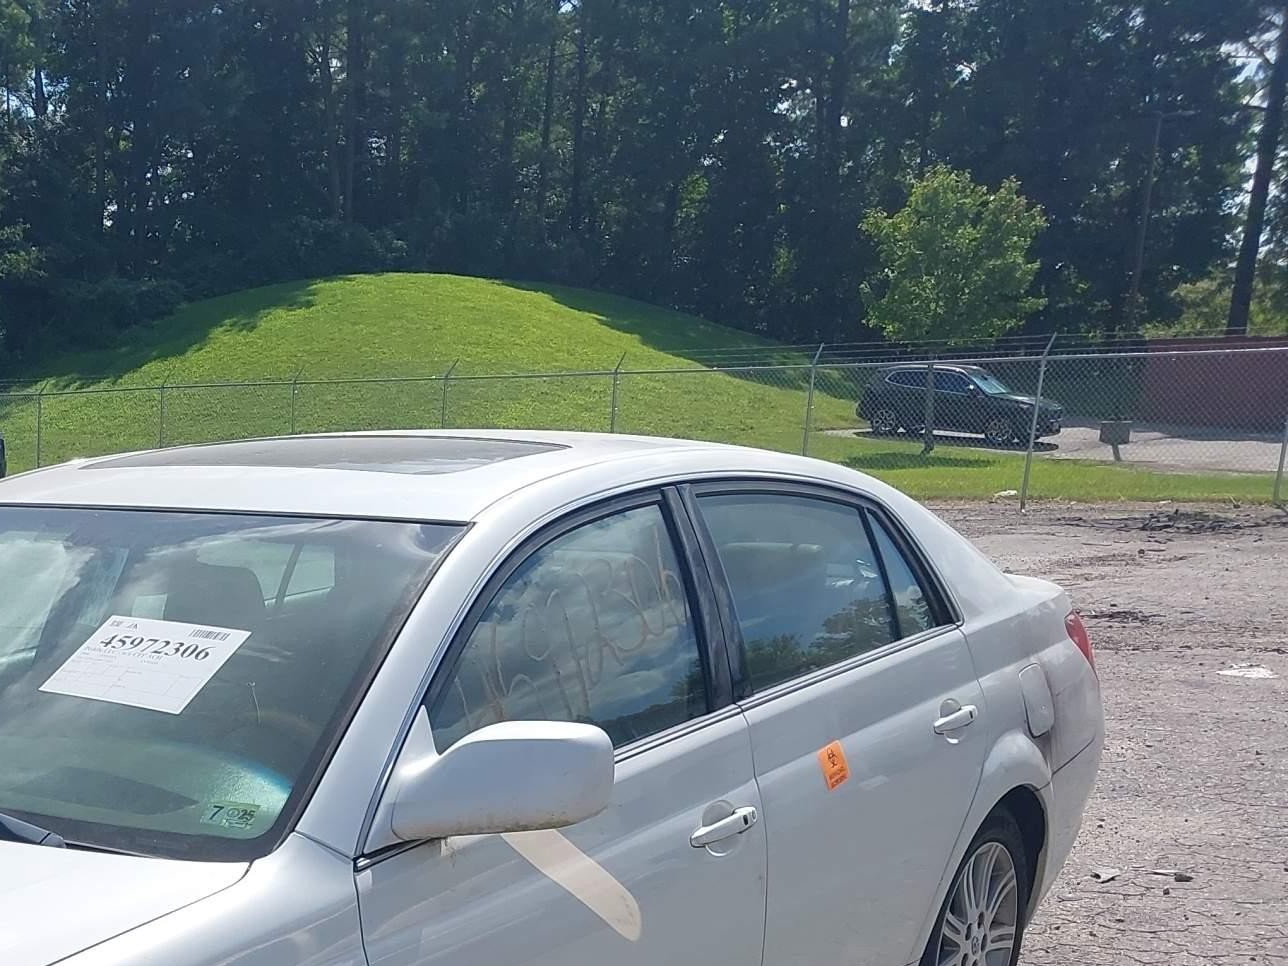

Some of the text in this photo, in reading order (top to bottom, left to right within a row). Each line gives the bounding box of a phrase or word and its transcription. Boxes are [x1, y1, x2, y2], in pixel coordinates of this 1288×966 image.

[100, 634, 216, 661] 45972306
[209, 805, 256, 821] 7 25
